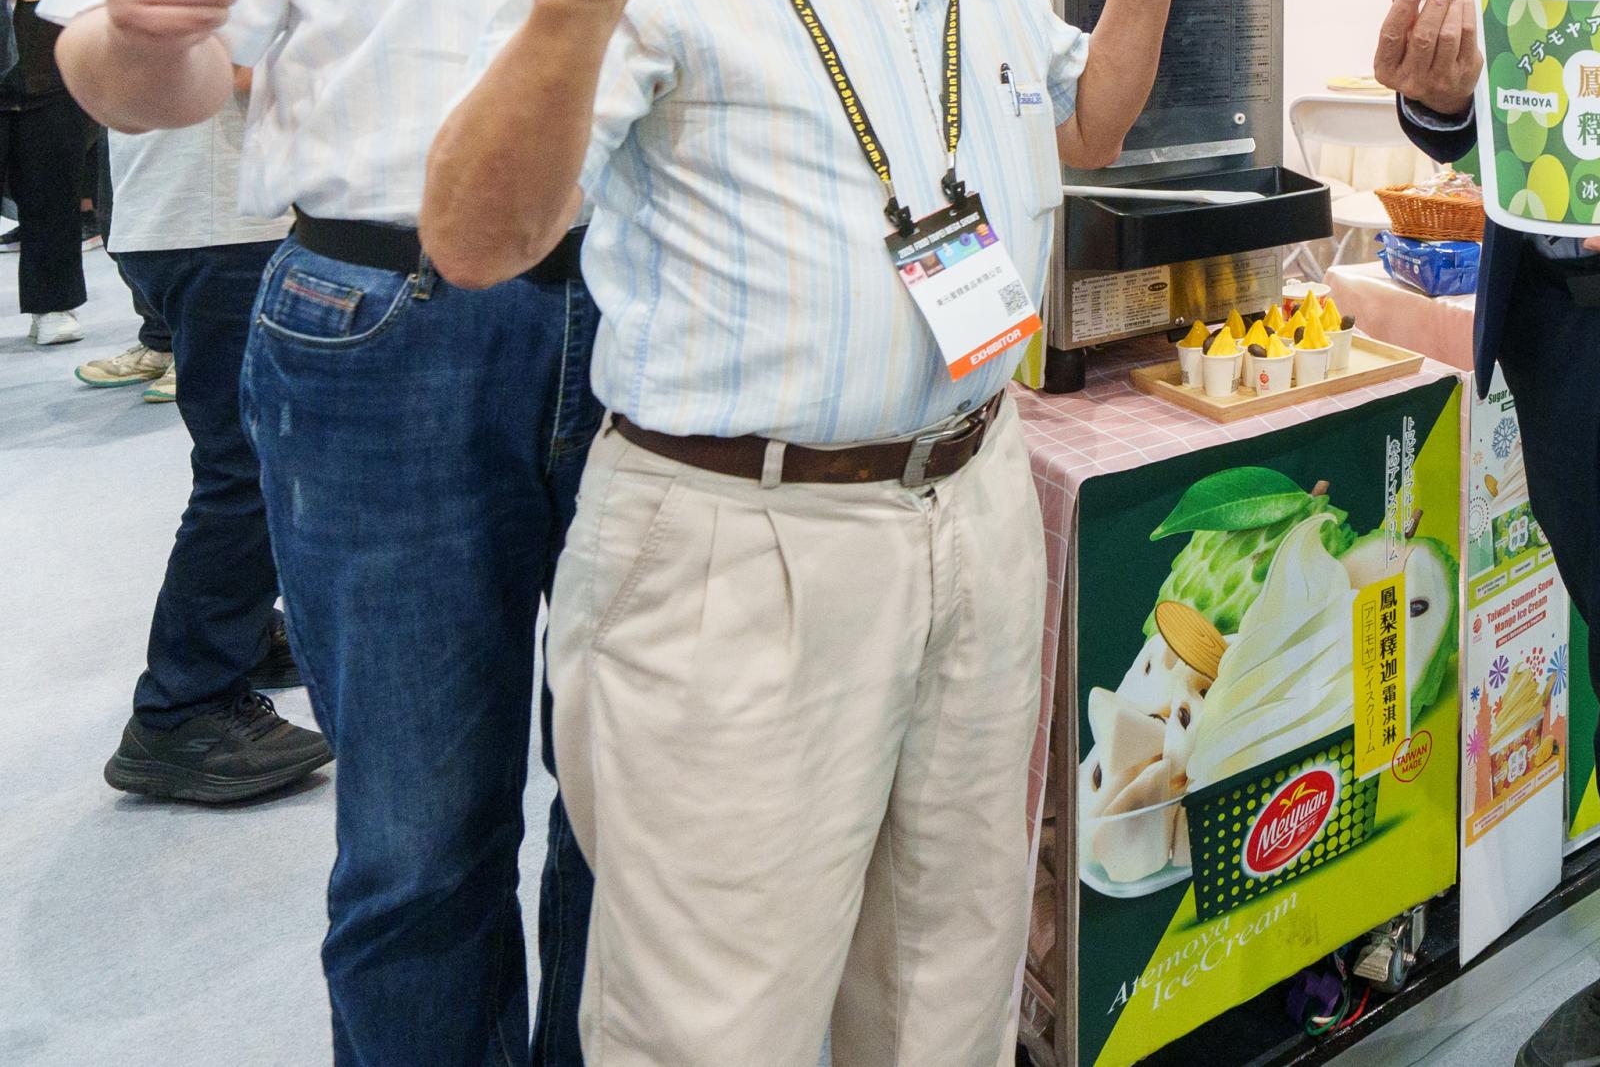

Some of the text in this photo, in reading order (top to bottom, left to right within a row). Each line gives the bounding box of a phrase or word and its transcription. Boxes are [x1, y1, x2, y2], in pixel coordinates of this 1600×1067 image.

[1502, 94, 1553, 109] ATEMOYA
[969, 328, 1023, 366] EXHIBITOR
[1488, 389, 1508, 405] Sugar
[1511, 587, 1537, 610] Summer
[1380, 585, 1399, 747] 鳳梨釋迦霜淇淋
[1395, 742, 1429, 768] TAIWAN
[1401, 755, 1424, 775] MADE
[1107, 916, 1231, 1016] Atemoya
